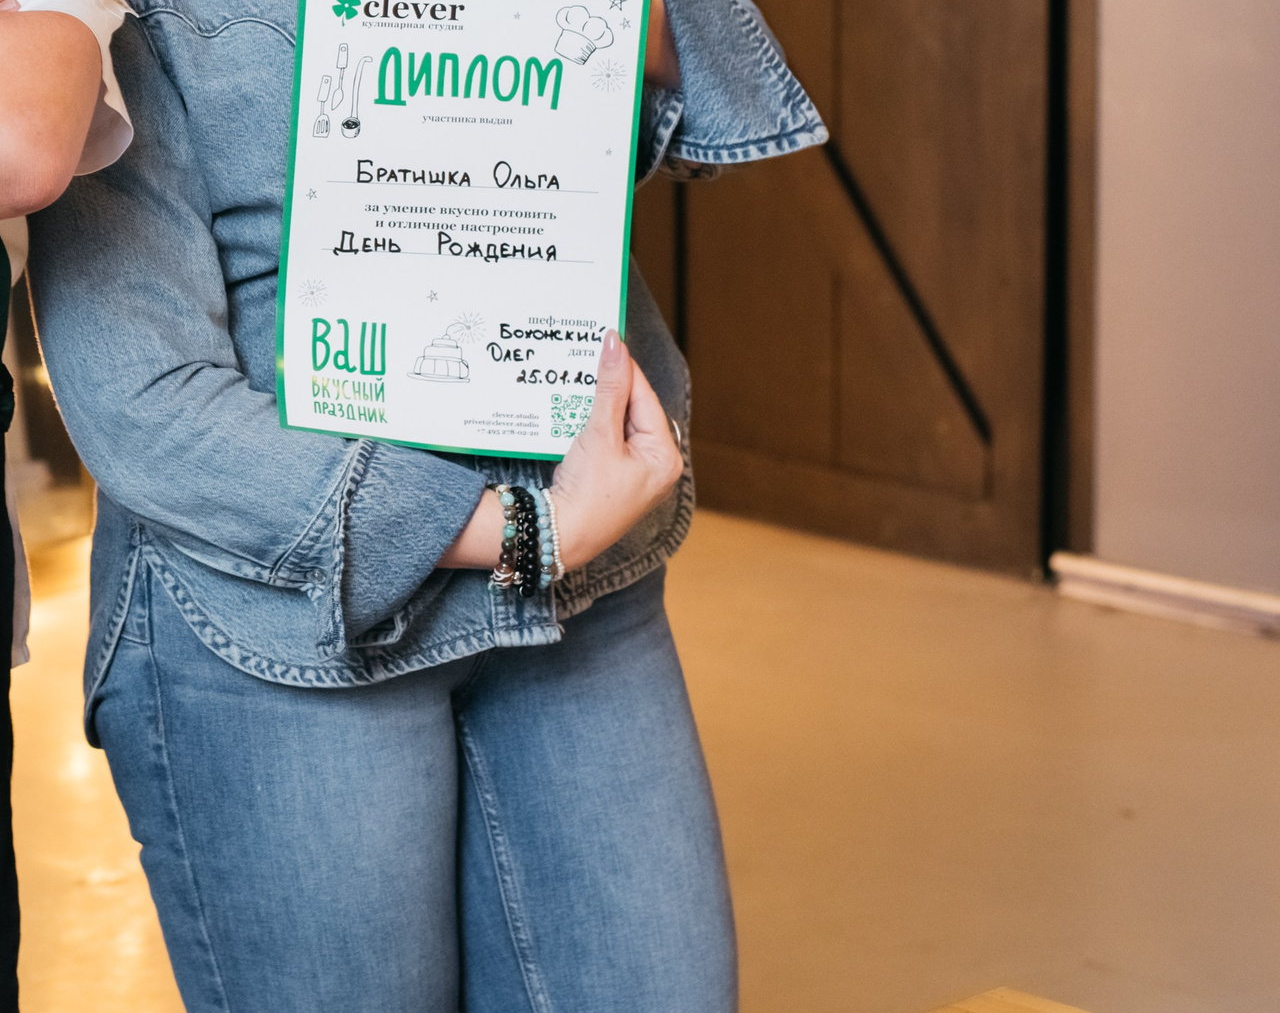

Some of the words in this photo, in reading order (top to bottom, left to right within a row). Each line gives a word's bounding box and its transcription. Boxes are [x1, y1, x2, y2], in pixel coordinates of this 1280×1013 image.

[361, 20, 425, 30] кулинарная
[428, 23, 464, 31] студия
[373, 46, 564, 111] ДИПЛОМ
[421, 114, 477, 124] участника
[479, 117, 514, 126] выдан
[364, 203, 380, 213] за
[383, 204, 436, 215] умение
[440, 206, 489, 218] вкусно
[492, 208, 557, 221] готовить
[375, 220, 384, 229] и
[388, 220, 457, 232] отличное
[460, 224, 545, 236] настроение
[528, 316, 597, 329] шеф-повар
[567, 348, 595, 357] дата
[492, 412, 539, 420] clever.studio
[464, 419, 539, 428] privet@clever.studio
